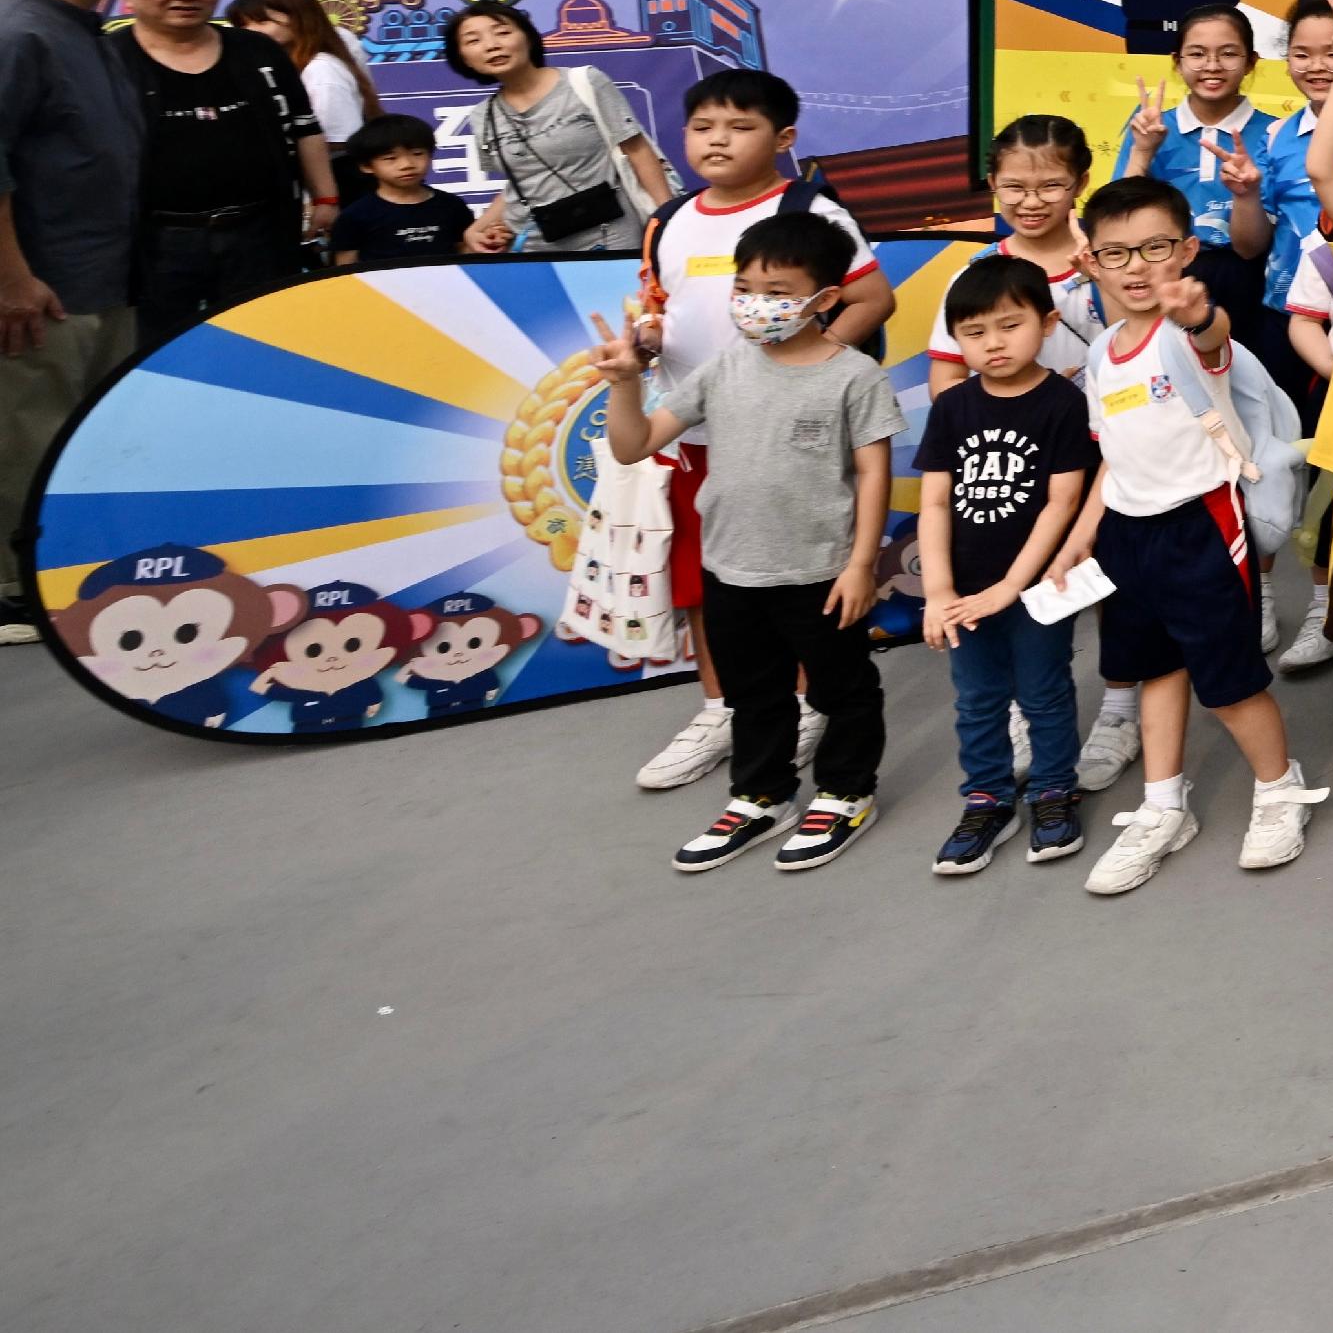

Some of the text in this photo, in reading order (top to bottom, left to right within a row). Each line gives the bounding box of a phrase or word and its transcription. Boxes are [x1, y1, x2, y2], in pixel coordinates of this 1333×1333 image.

[963, 451, 1025, 484] GAP
[967, 485, 1011, 500] 1969
[134, 556, 191, 580] RPL
[313, 589, 354, 607] RPL
[443, 598, 473, 613] RPL
